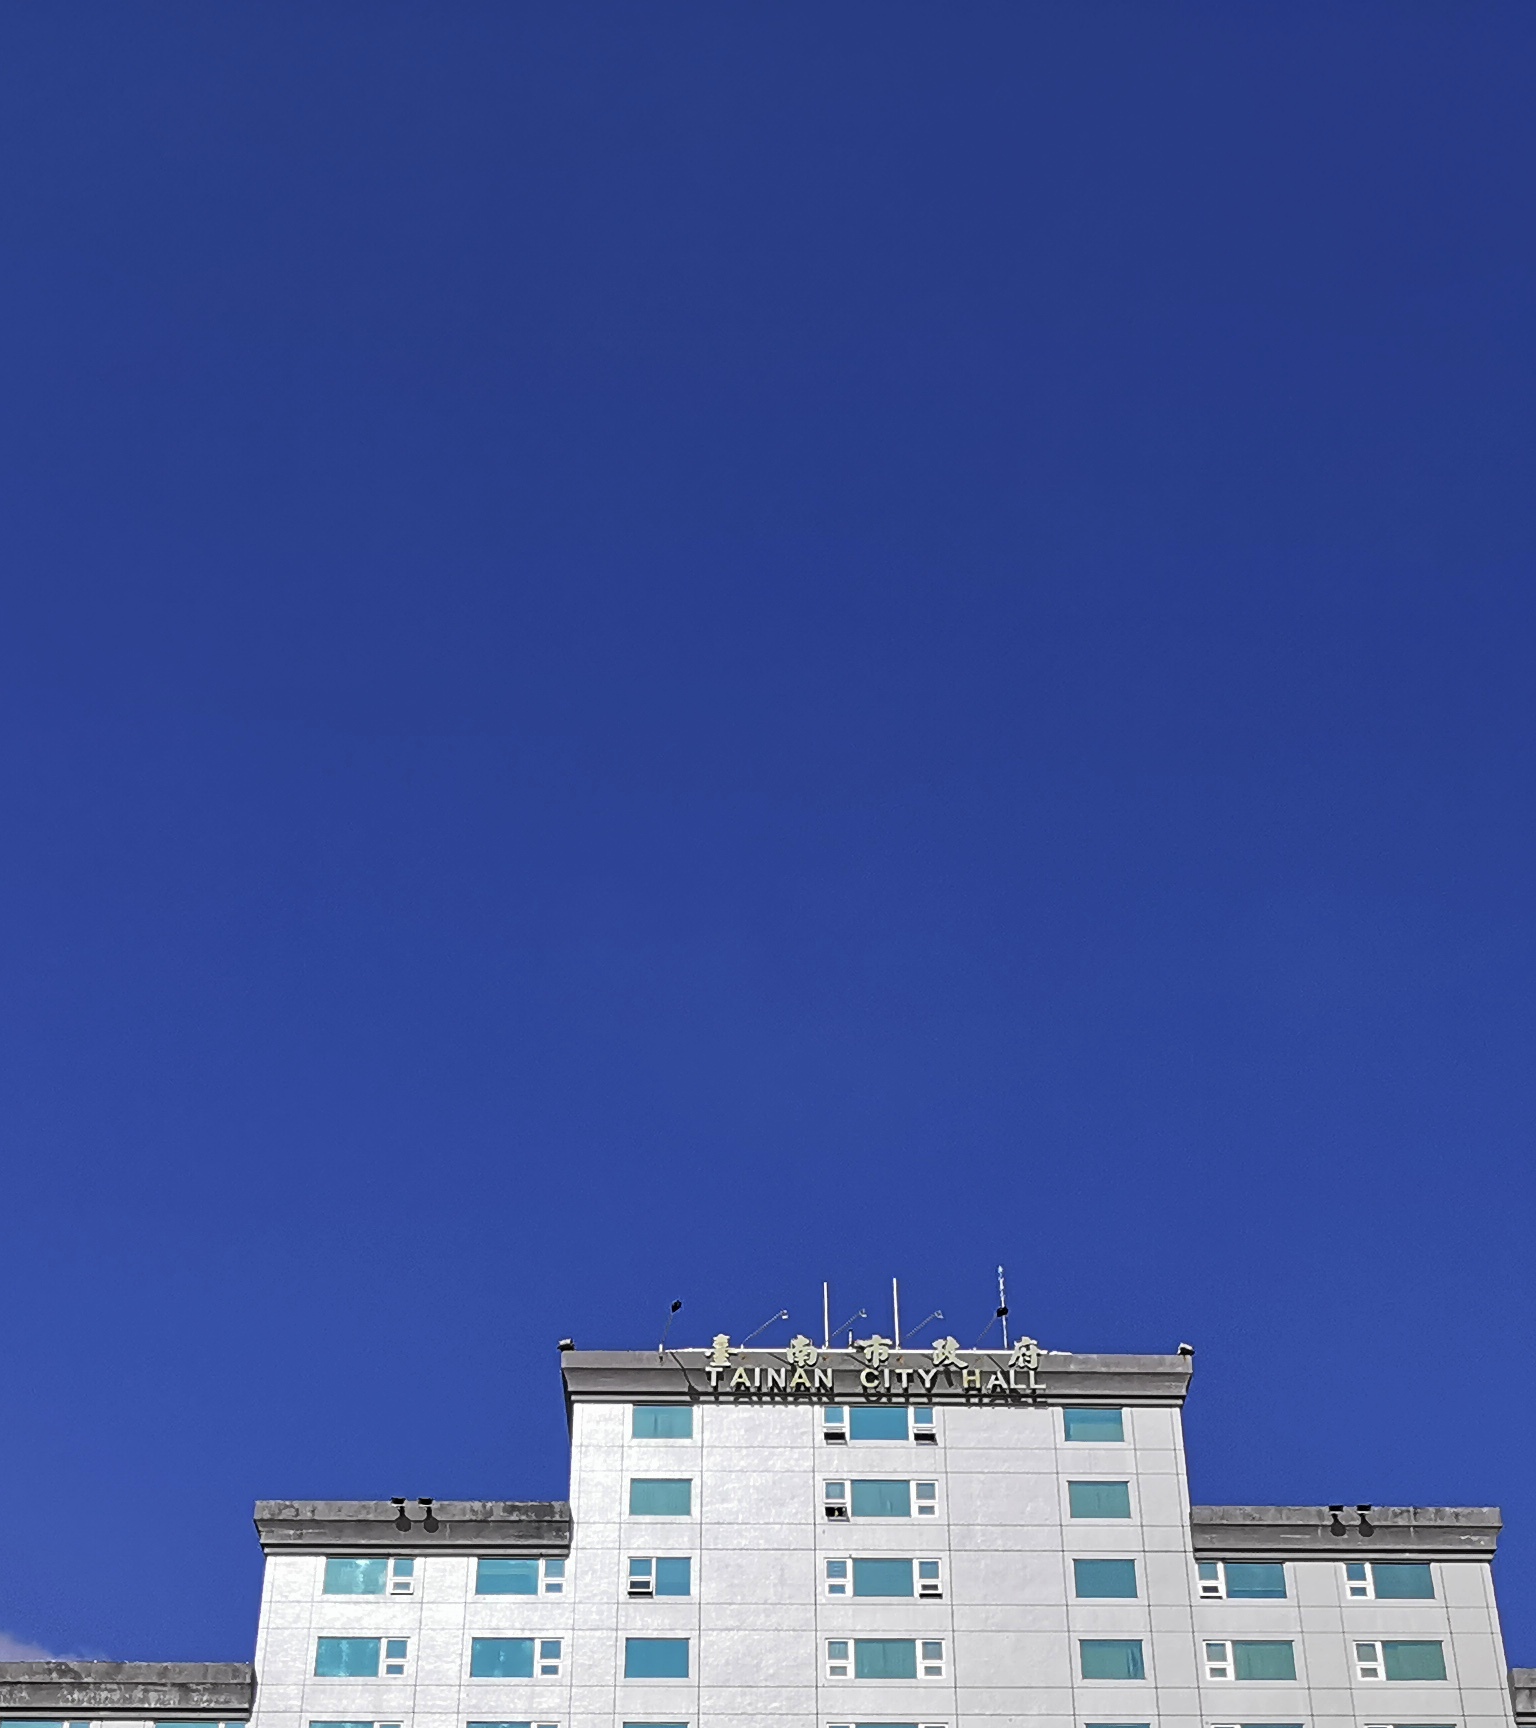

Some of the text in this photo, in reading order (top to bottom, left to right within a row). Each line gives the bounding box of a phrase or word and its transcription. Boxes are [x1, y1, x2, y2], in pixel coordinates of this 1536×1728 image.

[705, 1333, 1043, 1370] 臺南市政府
[705, 1367, 1047, 1390] TAINAN CITY HALL
